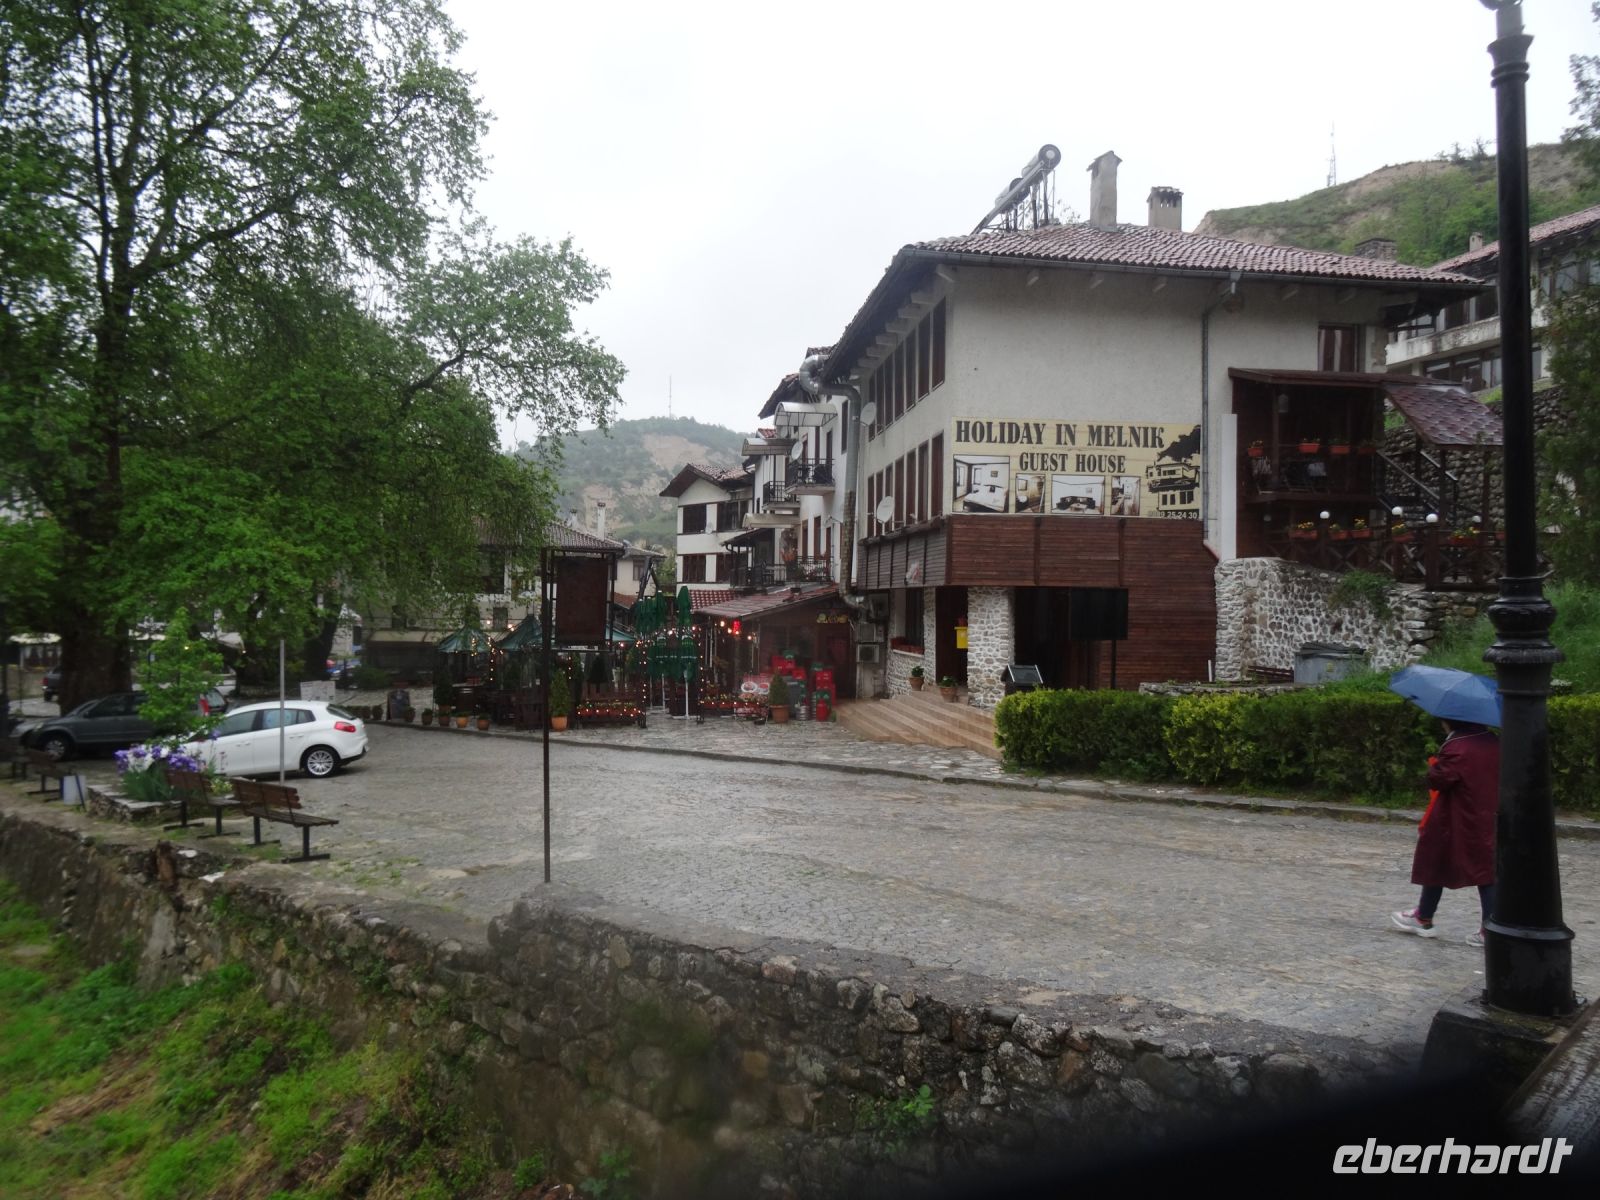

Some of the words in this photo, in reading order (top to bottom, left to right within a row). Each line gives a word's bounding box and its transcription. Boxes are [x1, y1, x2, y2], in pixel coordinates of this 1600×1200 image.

[955, 420, 1046, 445] HOLIDAY
[1055, 424, 1077, 446] IN
[1087, 425, 1165, 449] MELNIK
[1019, 452, 1068, 472] GUEST
[1075, 453, 1126, 473] HOUSE
